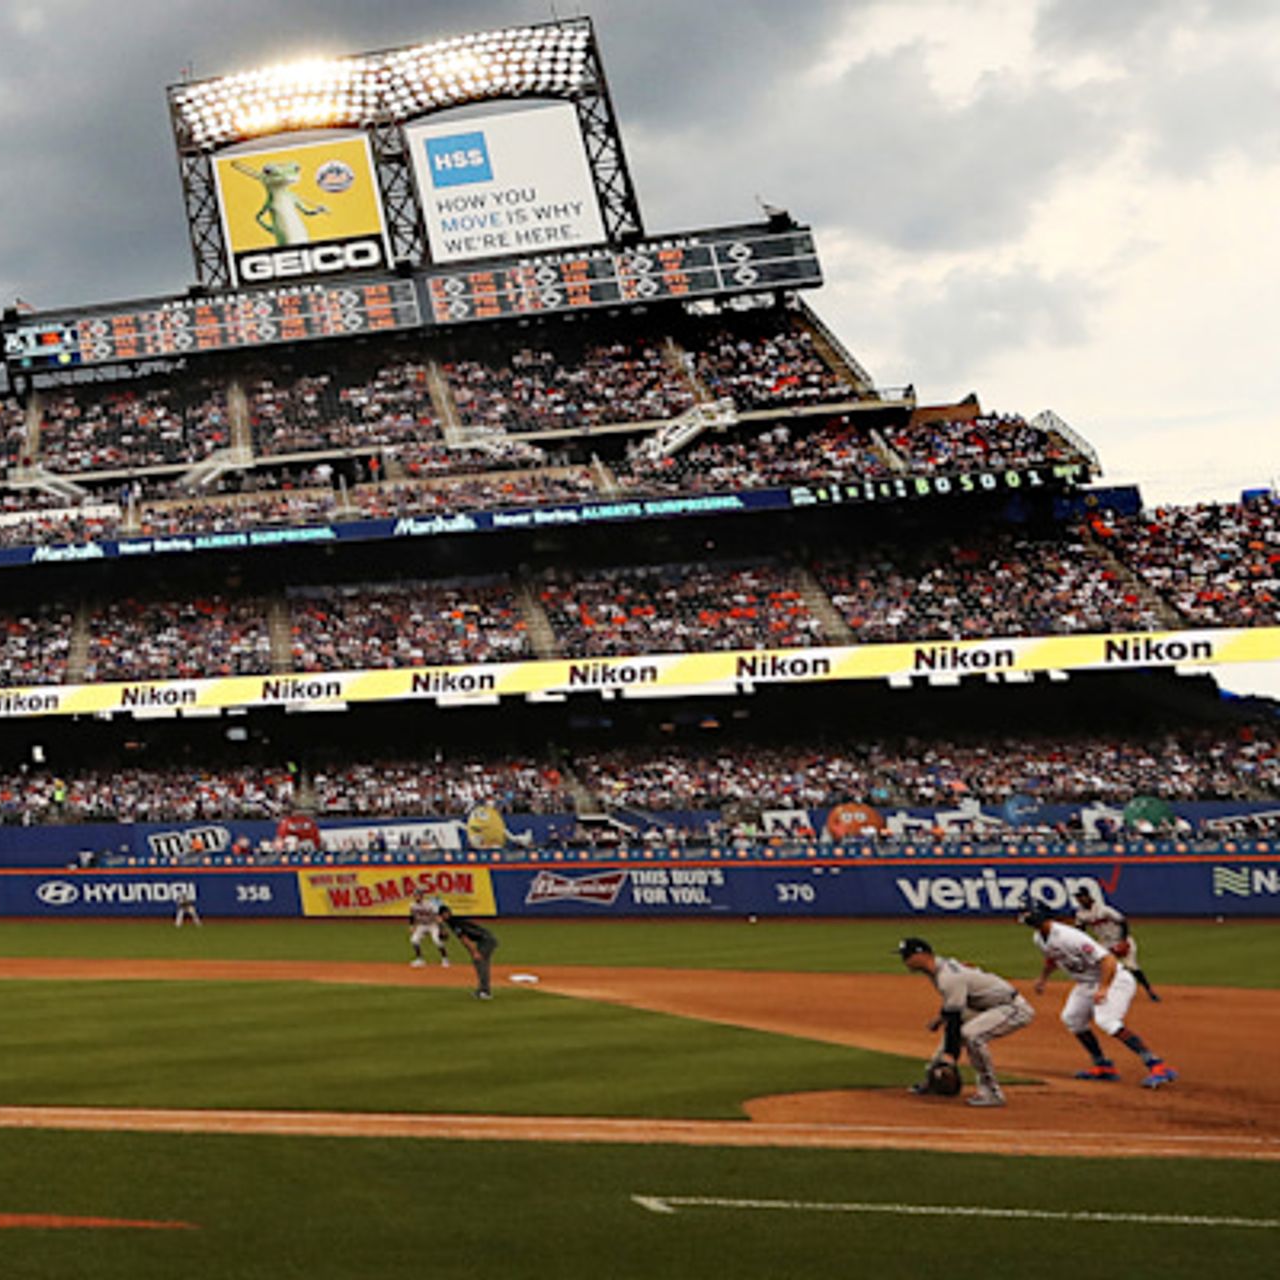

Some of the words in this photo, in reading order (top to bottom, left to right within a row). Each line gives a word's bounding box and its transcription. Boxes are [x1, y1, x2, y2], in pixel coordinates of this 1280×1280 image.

[434, 152, 486, 170] HSS
[437, 194, 485, 213] HOW
[491, 187, 537, 205] YOU
[441, 211, 502, 232] MOVE
[506, 208, 528, 224] IS
[532, 201, 583, 220] WHY
[444, 231, 510, 253] WE'RE
[515, 224, 581, 245] HERE.
[240, 240, 381, 281] GEICO
[394, 512, 477, 536] Marshalls
[582, 501, 642, 520] ALWAYS
[33, 540, 104, 564] Marshalls
[121, 685, 197, 709] Nikon
[261, 677, 342, 701] Nikon
[411, 670, 496, 695] Nikon
[568, 660, 658, 687] Nikon
[736, 653, 831, 679] Nikon
[913, 645, 1015, 672] Nikon
[1103, 637, 1213, 665] Nikon
[630, 869, 668, 885] THIS
[671, 869, 725, 886] BUD'S
[896, 868, 1104, 911] verizon
[83, 881, 197, 902] HYUNDAI
[236, 885, 271, 901] 358
[633, 887, 668, 903] FOR
[776, 883, 815, 902] 370
